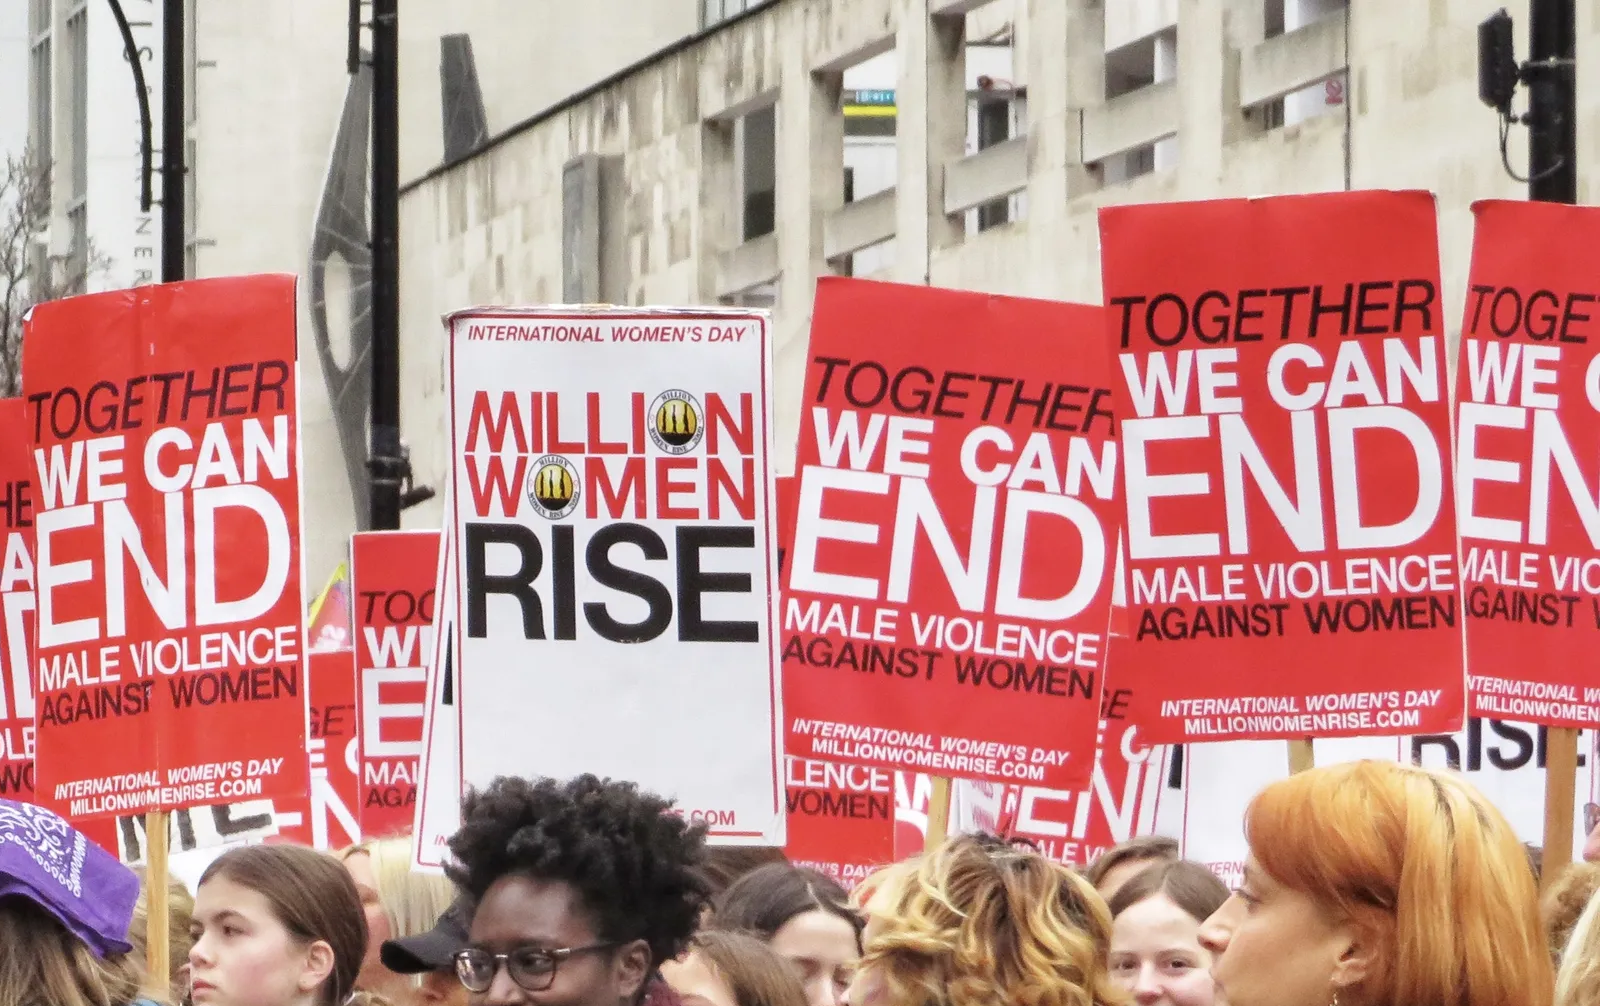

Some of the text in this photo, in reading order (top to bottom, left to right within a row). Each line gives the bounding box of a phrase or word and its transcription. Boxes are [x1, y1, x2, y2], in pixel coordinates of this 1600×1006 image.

[468, 324, 746, 343] INTERNATIONAL WOMEN'S DAY
[1111, 280, 1435, 348] TOGETHER
[1468, 285, 1600, 344] TOGE
[29, 361, 289, 442] TOGETHER
[811, 357, 1115, 436] TOGETHER
[1119, 337, 1439, 416] WE CAN
[1466, 339, 1561, 410] WE
[35, 415, 289, 509] WE CAN
[813, 407, 1116, 500] WE CAN
[1122, 402, 1443, 558] END
[36, 486, 290, 648] END
[788, 466, 1105, 621] END
[465, 522, 759, 643] RISE
[1132, 554, 1454, 604] MALE VIOLENCE
[786, 599, 1098, 668] MALE VIOLENCE
[1136, 596, 1455, 642] AGAINST WOMEN
[39, 626, 297, 692] MALE VIOLENCE
[782, 638, 1095, 700] AGAINST WOMEN
[40, 665, 297, 727] AGAINST WOMEN
[1160, 690, 1441, 717] INTERNATIONAL WOMEN'S DAY
[1184, 710, 1419, 735] MILLIONWOMENRISE.COM
[793, 718, 1070, 767] INTERNATIONAL WOMEN'S DAY
[812, 738, 1045, 781] MILLIONWOMENRISE.COM
[55, 757, 284, 800] INTERNATIONAL WOMEN'S DAY
[70, 778, 262, 817] MILLIONWOMENRISE.COM
